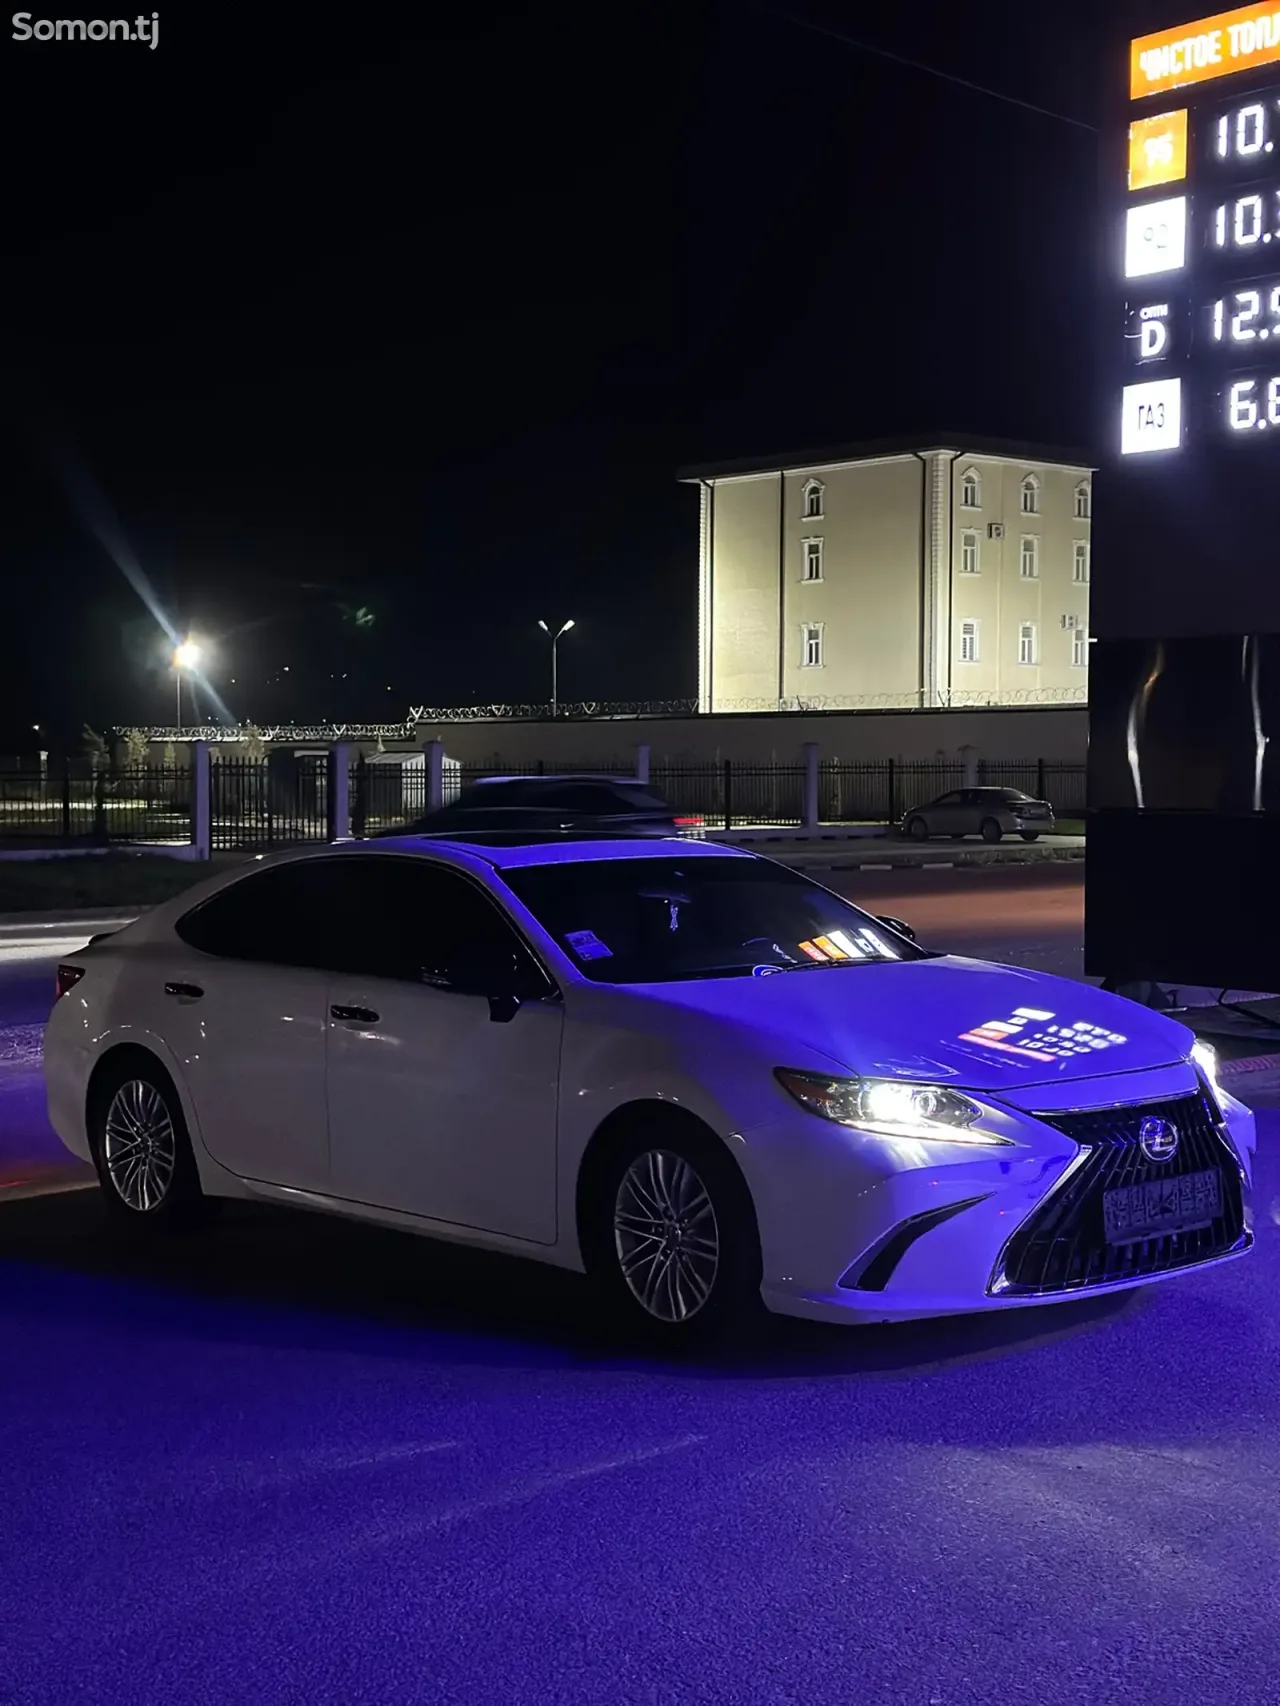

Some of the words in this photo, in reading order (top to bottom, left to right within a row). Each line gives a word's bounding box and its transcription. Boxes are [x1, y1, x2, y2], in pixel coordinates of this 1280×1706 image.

[1140, 30, 1222, 81] ЧИСТОЕ
[1217, 100, 1280, 157] 10.
[1215, 190, 1280, 247] 10.
[1141, 320, 1166, 357] D
[1138, 403, 1165, 430] ГАЗ
